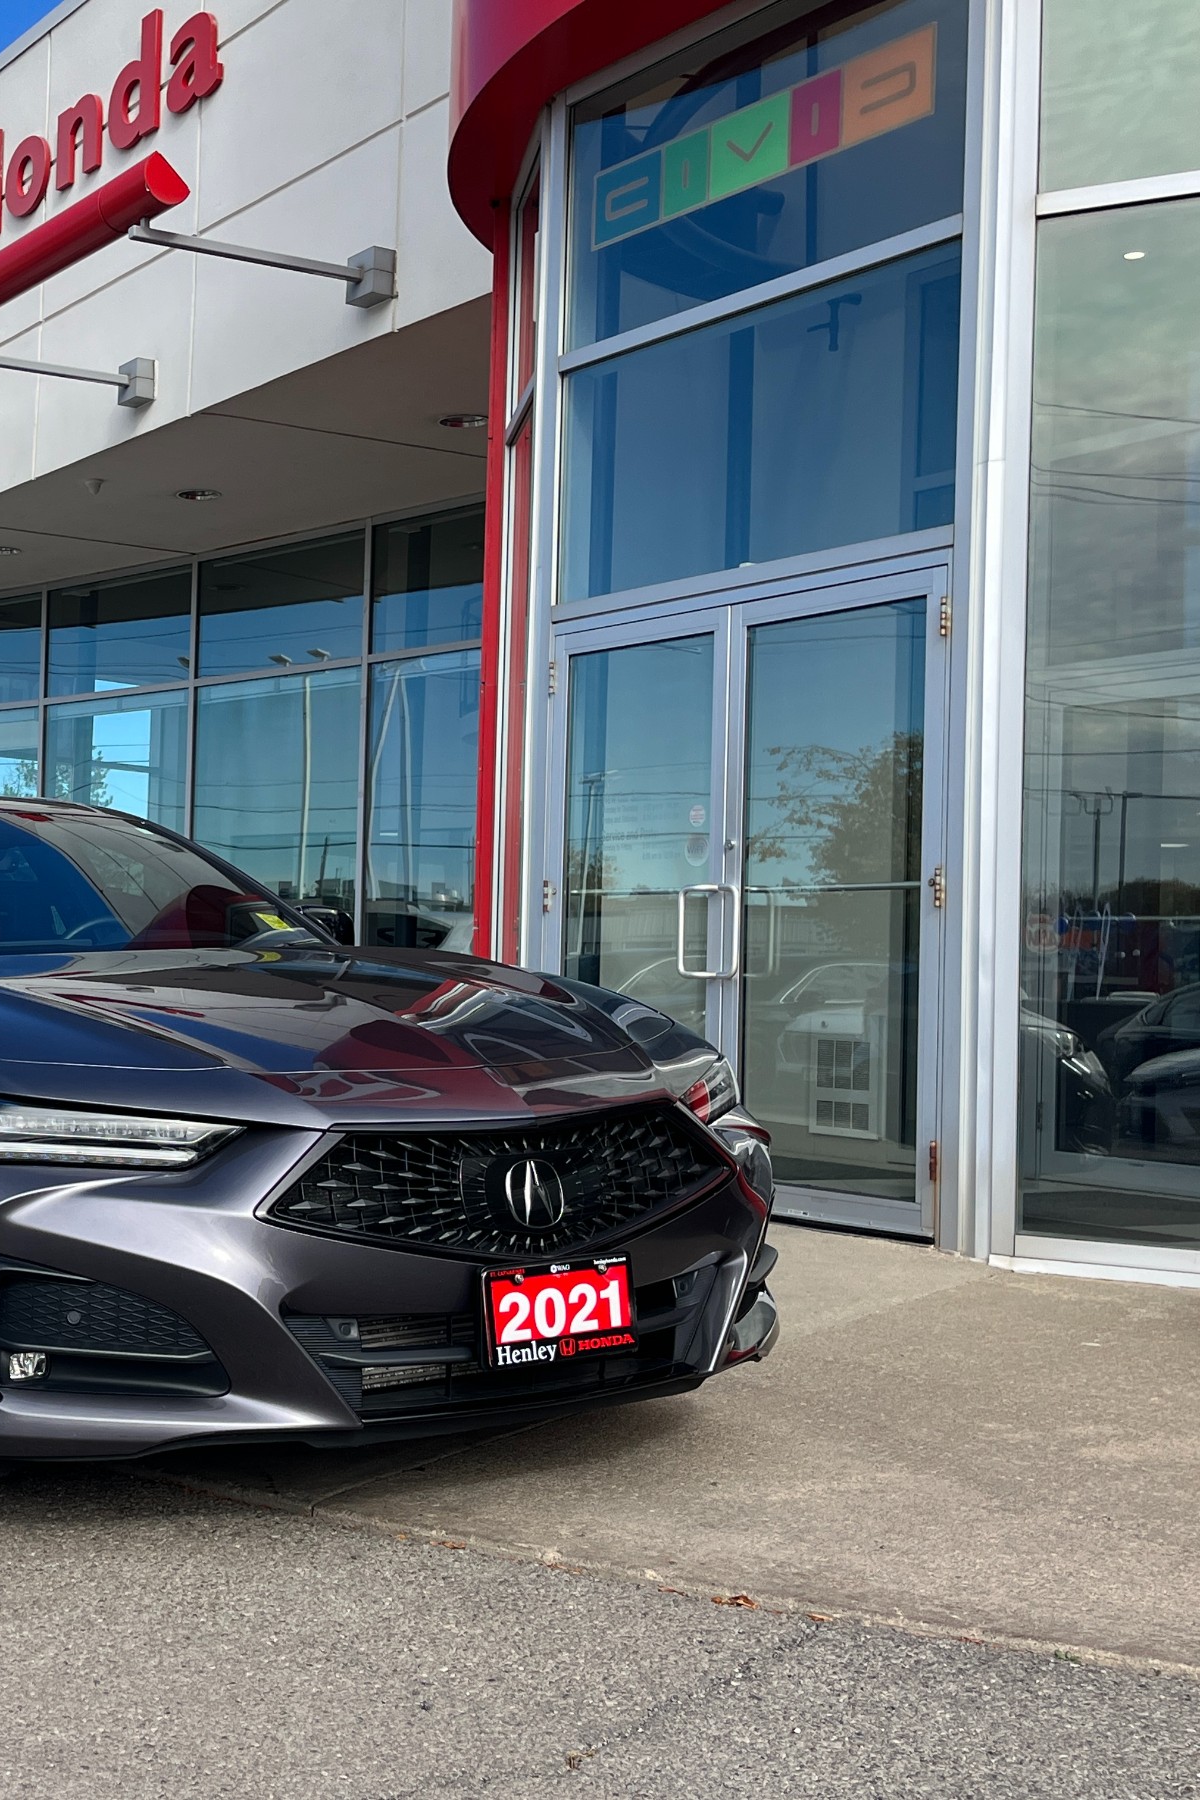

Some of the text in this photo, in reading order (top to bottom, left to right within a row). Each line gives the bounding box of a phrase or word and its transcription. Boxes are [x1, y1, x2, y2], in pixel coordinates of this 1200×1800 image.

[498, 1279, 623, 1343] 2021
[496, 1333, 635, 1365] Henley HONDA
